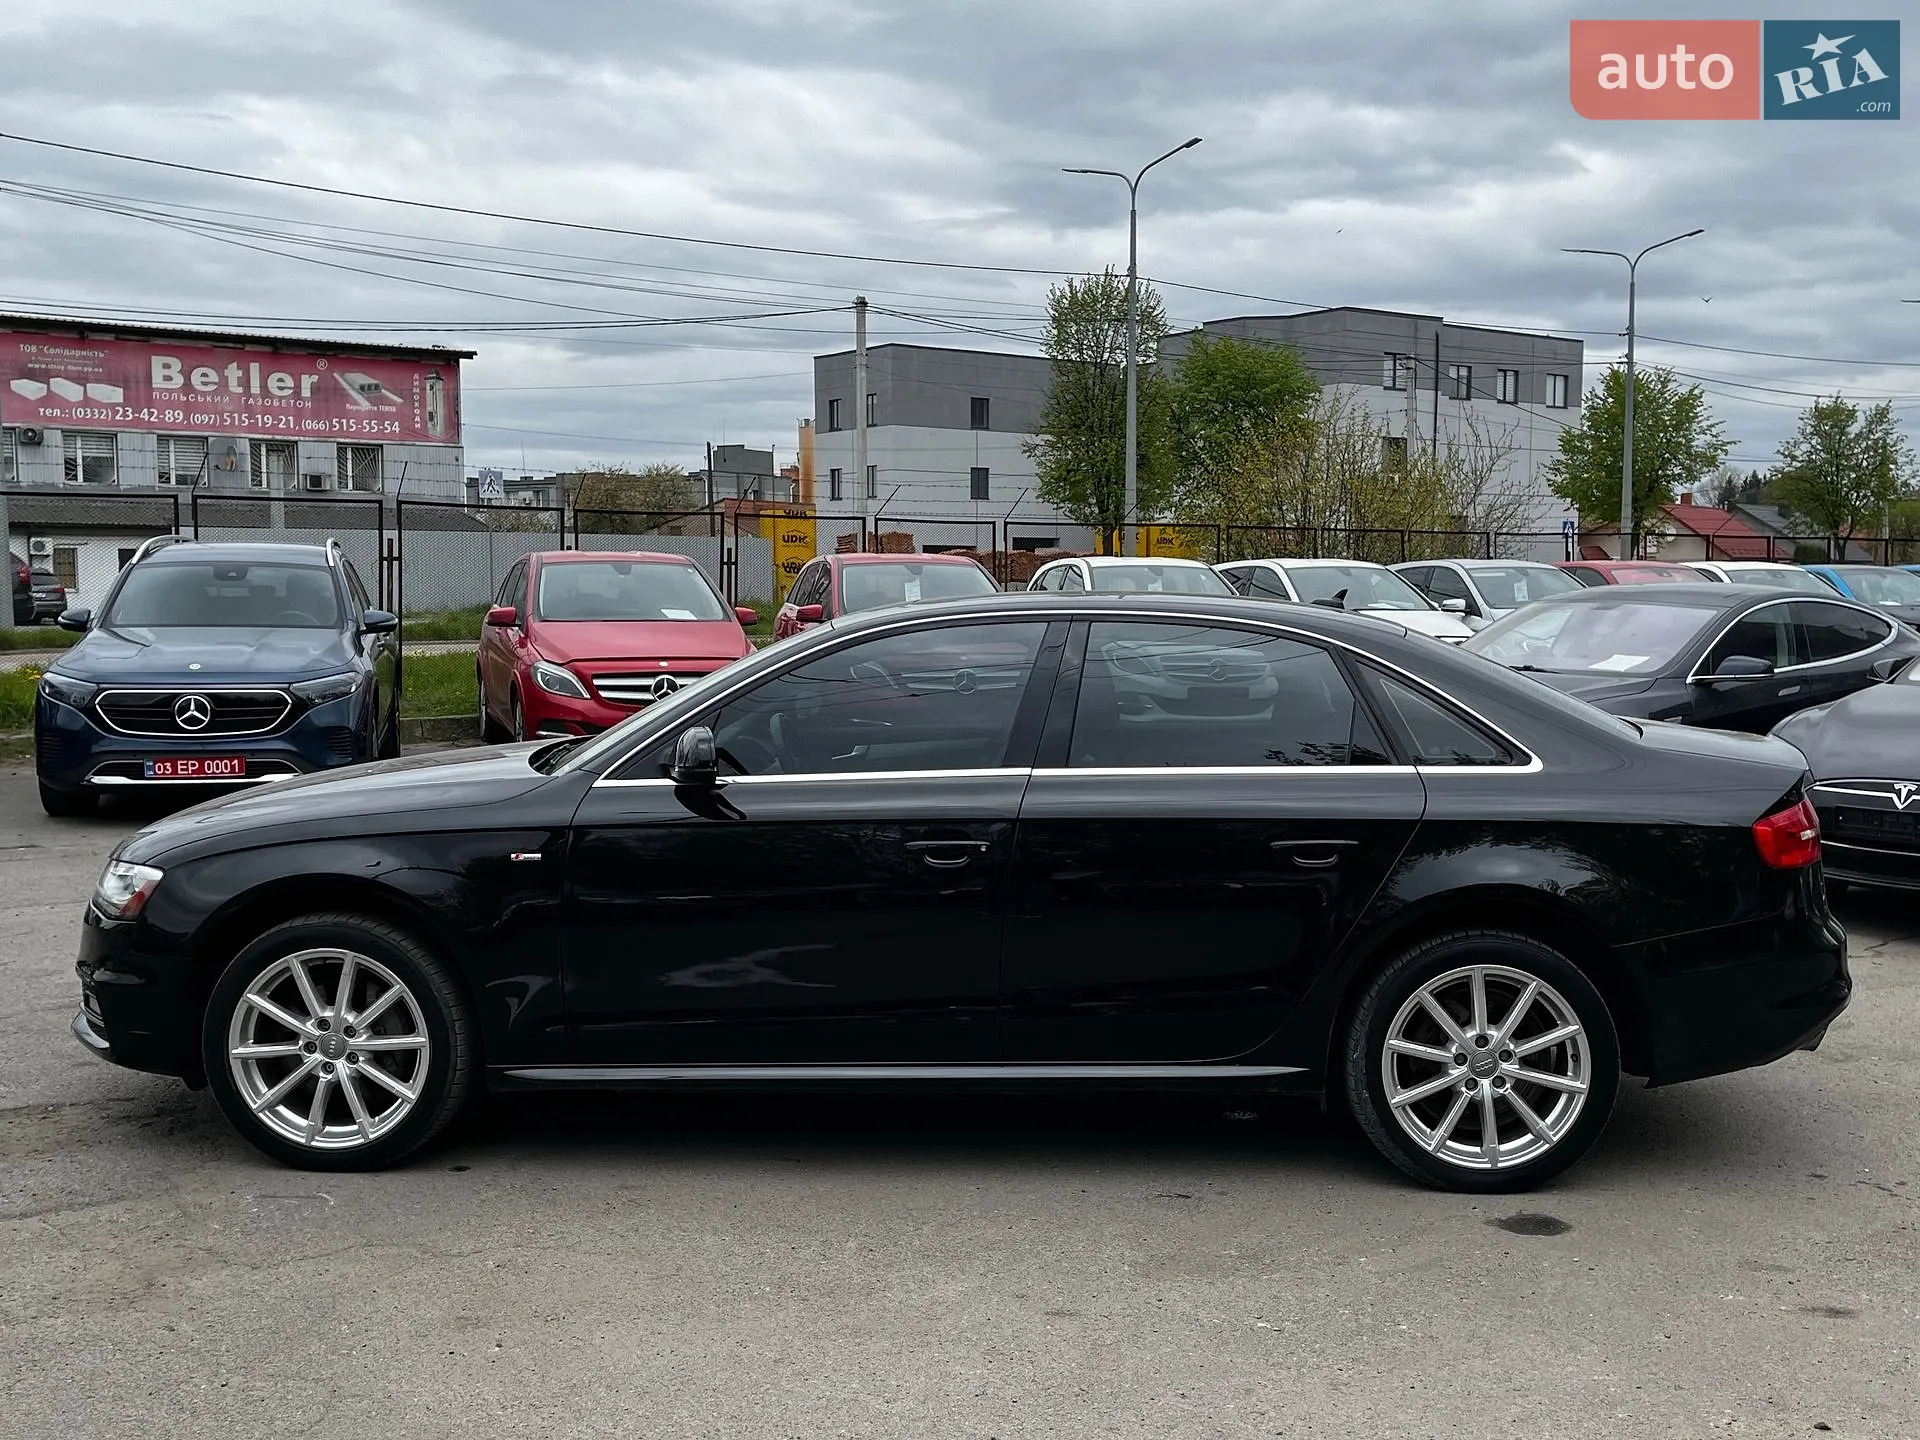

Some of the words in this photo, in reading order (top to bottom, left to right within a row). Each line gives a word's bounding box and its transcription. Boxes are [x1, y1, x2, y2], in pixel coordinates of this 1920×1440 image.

[19, 343, 38, 353] ТОВ
[151, 355, 319, 398] Betler
[241, 396, 312, 409] ГАЗОБЕТОН
[38, 407, 70, 418] тел.:
[72, 408, 112, 421] (0332)
[190, 413, 220, 426] (097)
[301, 418, 330, 432] (066)
[331, 419, 401, 434] 515-55-54
[782, 534, 808, 545] UDK
[155, 762, 173, 774] 03
[177, 759, 200, 775] EP
[204, 759, 240, 774] 0001
